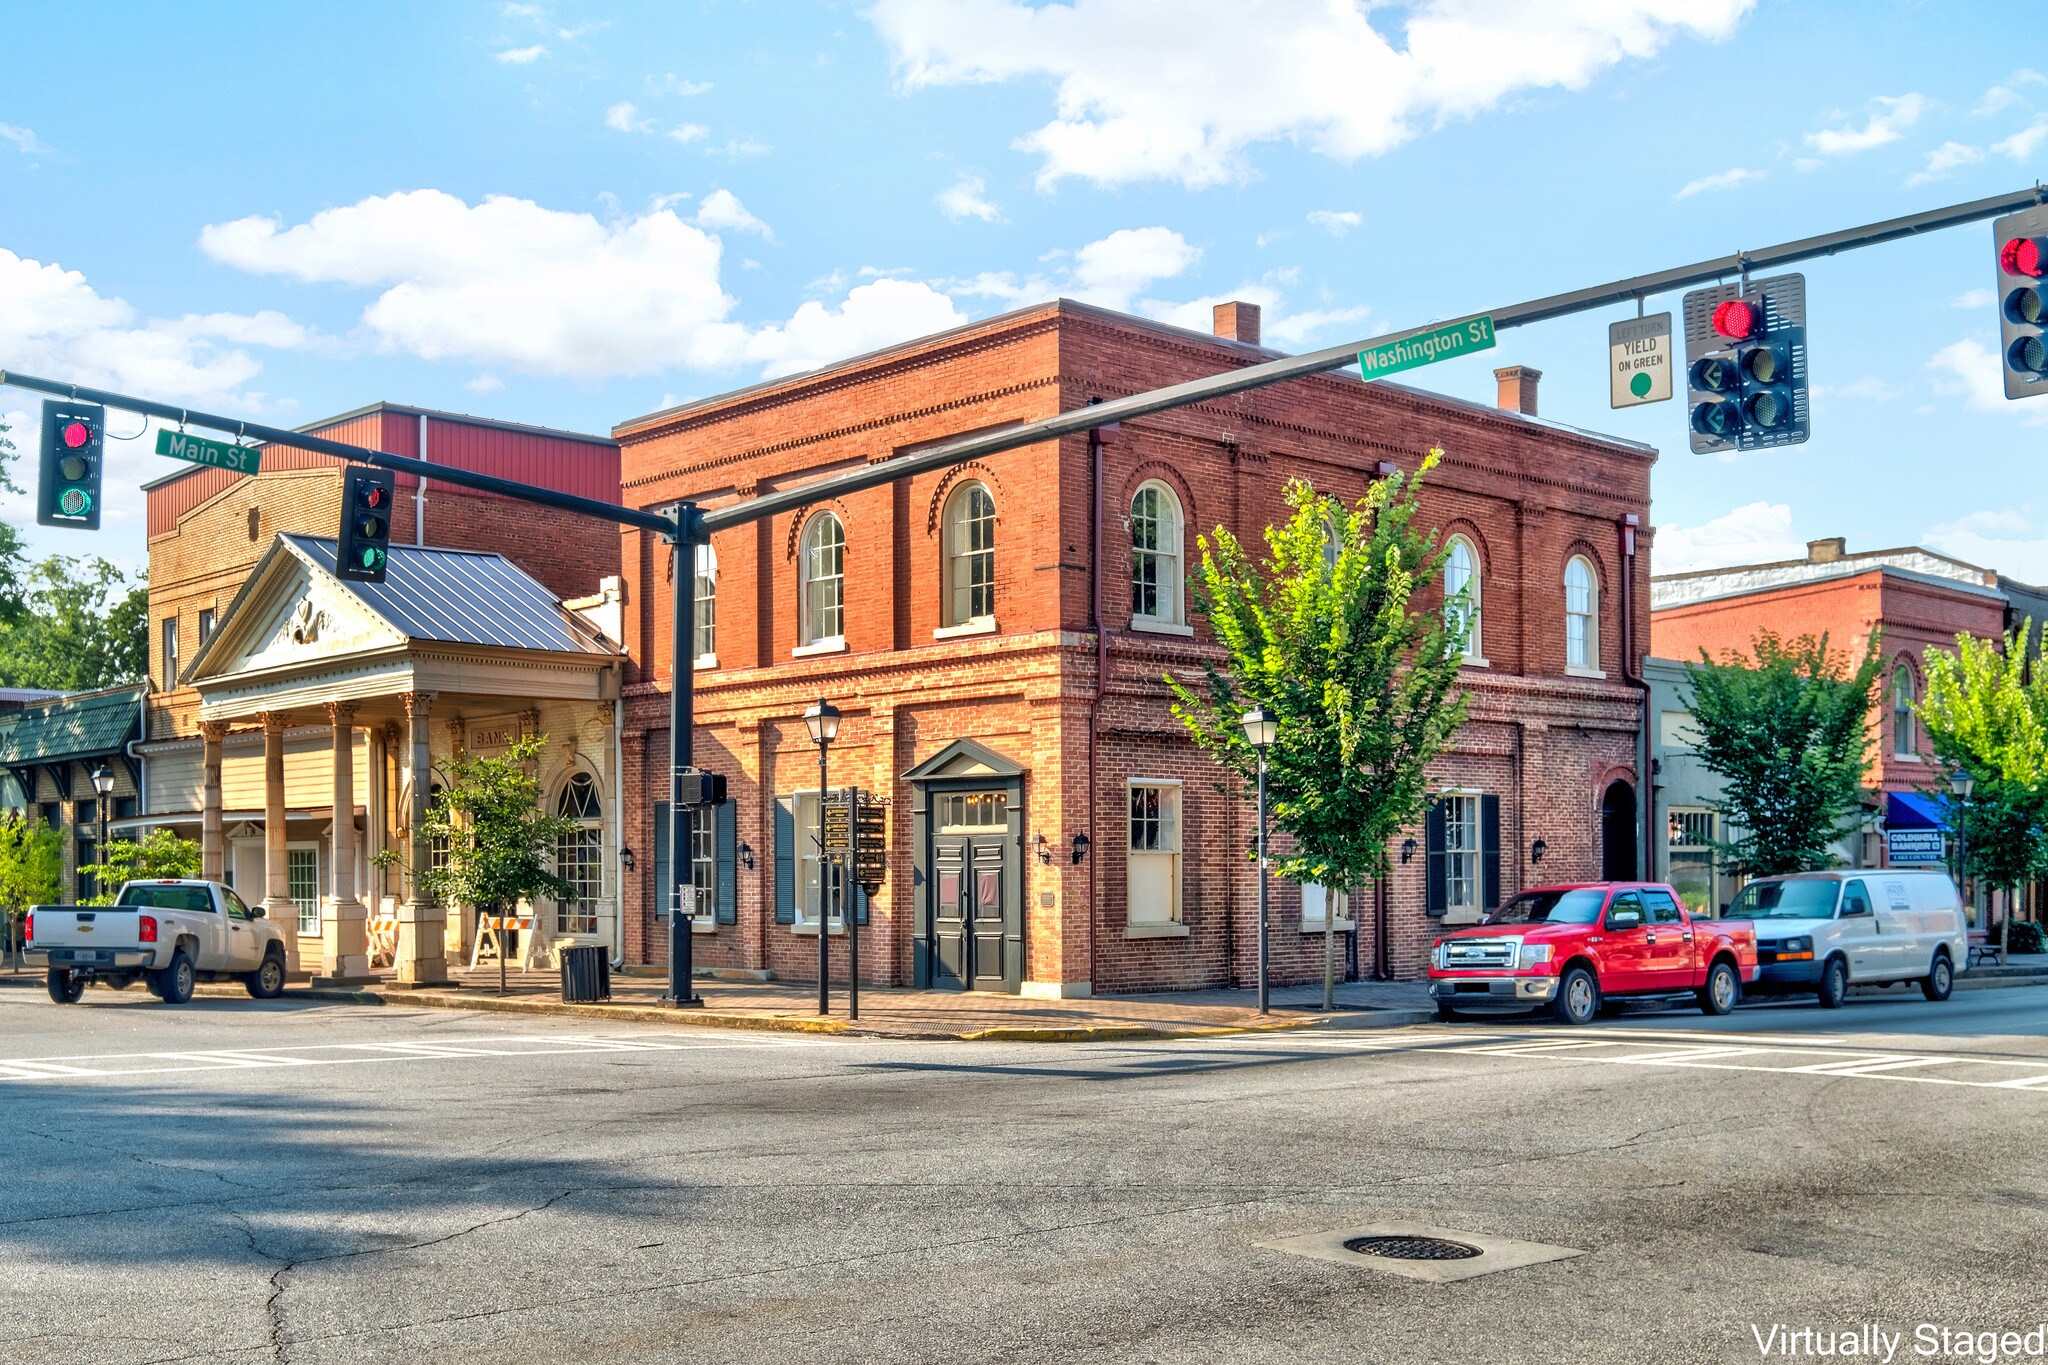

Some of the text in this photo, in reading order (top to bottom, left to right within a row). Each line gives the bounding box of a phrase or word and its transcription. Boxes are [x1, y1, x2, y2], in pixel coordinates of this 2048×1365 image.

[1616, 322, 1663, 340] LEFT TURN
[1364, 320, 1489, 371] Washington St
[1624, 338, 1657, 356] YIELD
[1618, 354, 1663, 372] ON GREEN
[169, 434, 247, 470] Main St
[1891, 833, 1940, 841] COLDWELL
[1891, 842, 1931, 851] BANKER
